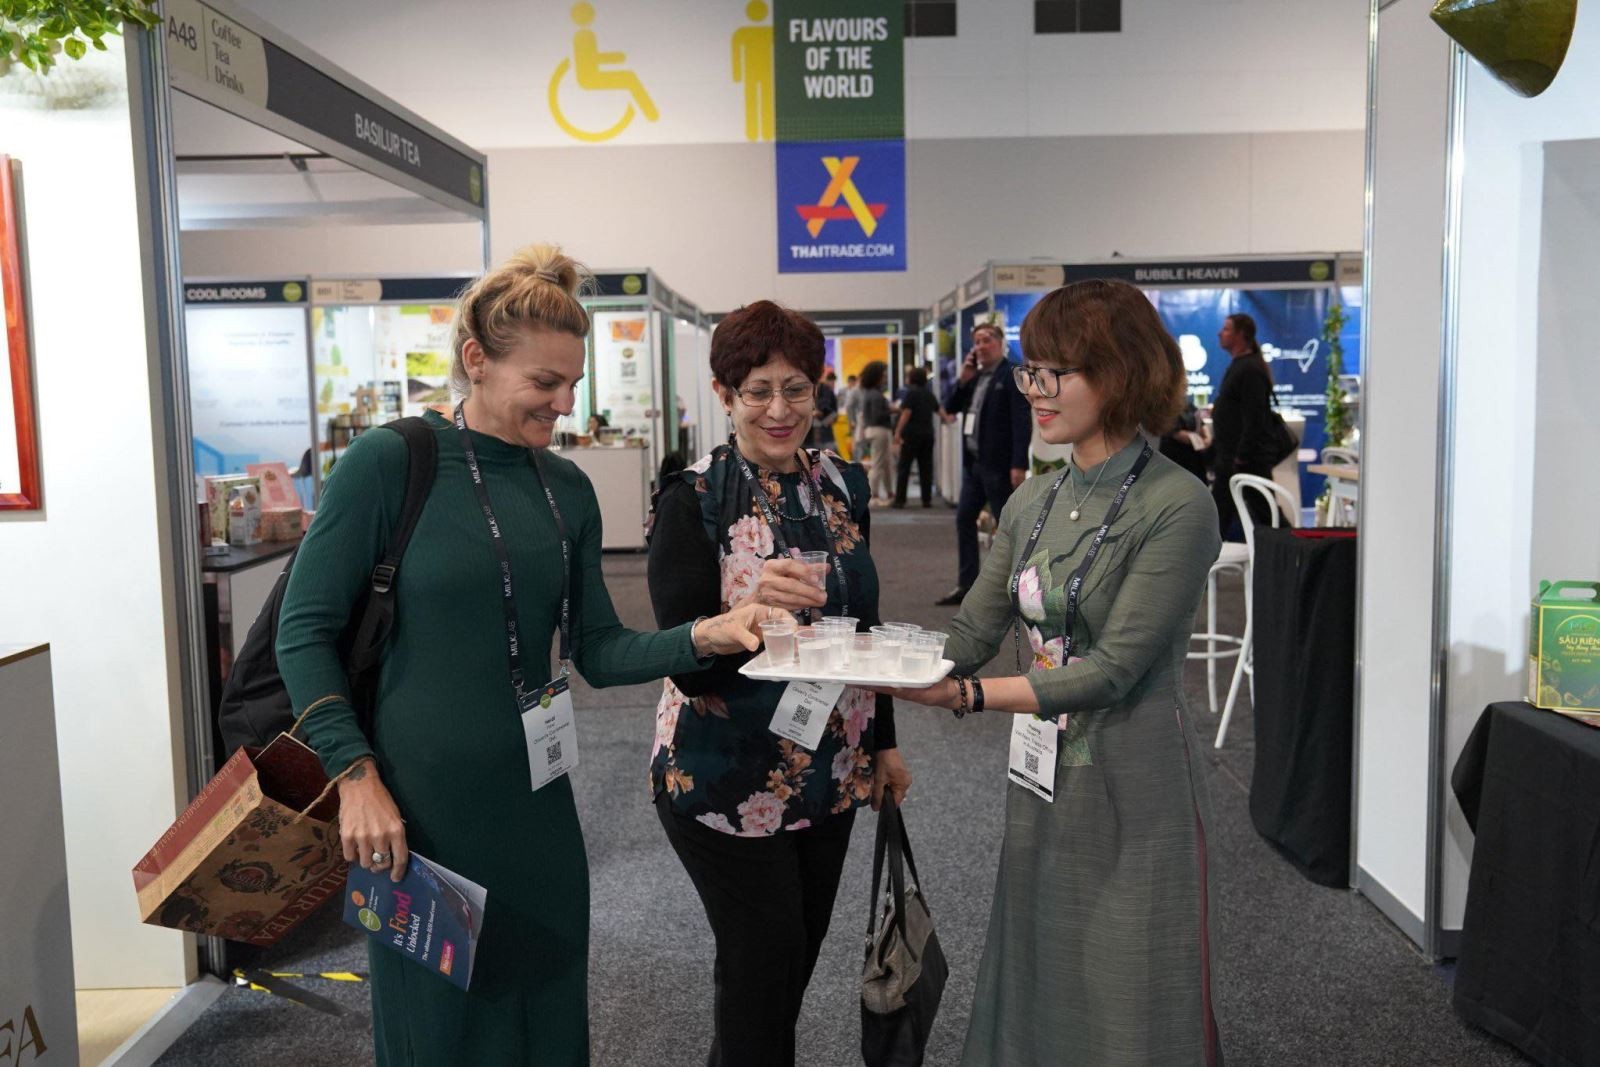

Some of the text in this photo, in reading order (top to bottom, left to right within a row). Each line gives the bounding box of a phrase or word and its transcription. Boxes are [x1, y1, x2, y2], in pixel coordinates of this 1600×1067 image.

[168, 16, 198, 51] A48
[212, 18, 241, 49] Coffee
[790, 17, 888, 42] FLAVOURS
[214, 42, 230, 65] Tea
[805, 46, 872, 71] OF THE
[214, 65, 244, 95] Drinks
[804, 74, 874, 99] WORLD
[355, 112, 421, 167] BASILUR TEA
[790, 243, 895, 258] THAITRADE.COM
[1135, 267, 1239, 281] BUBBLE HEAVEN
[187, 287, 266, 300] COOLROOMS
[465, 451, 481, 484] MILKLAB
[1114, 474, 1136, 504] MILKLAB
[483, 505, 501, 538] MILKLAB
[1030, 508, 1048, 540] MILKLAB
[1087, 524, 1109, 557] MILKLAB
[502, 560, 512, 598] MILKLAB
[1067, 577, 1081, 612] MILKLAB
[509, 621, 518, 656] MILKLAB
[206, 754, 242, 794] EXCLUSIVE
[176, 792, 209, 827] PREMIUM
[255, 913, 302, 940] TEA
[387, 890, 412, 946] It's Food
[407, 914, 421, 952] Unlocked
